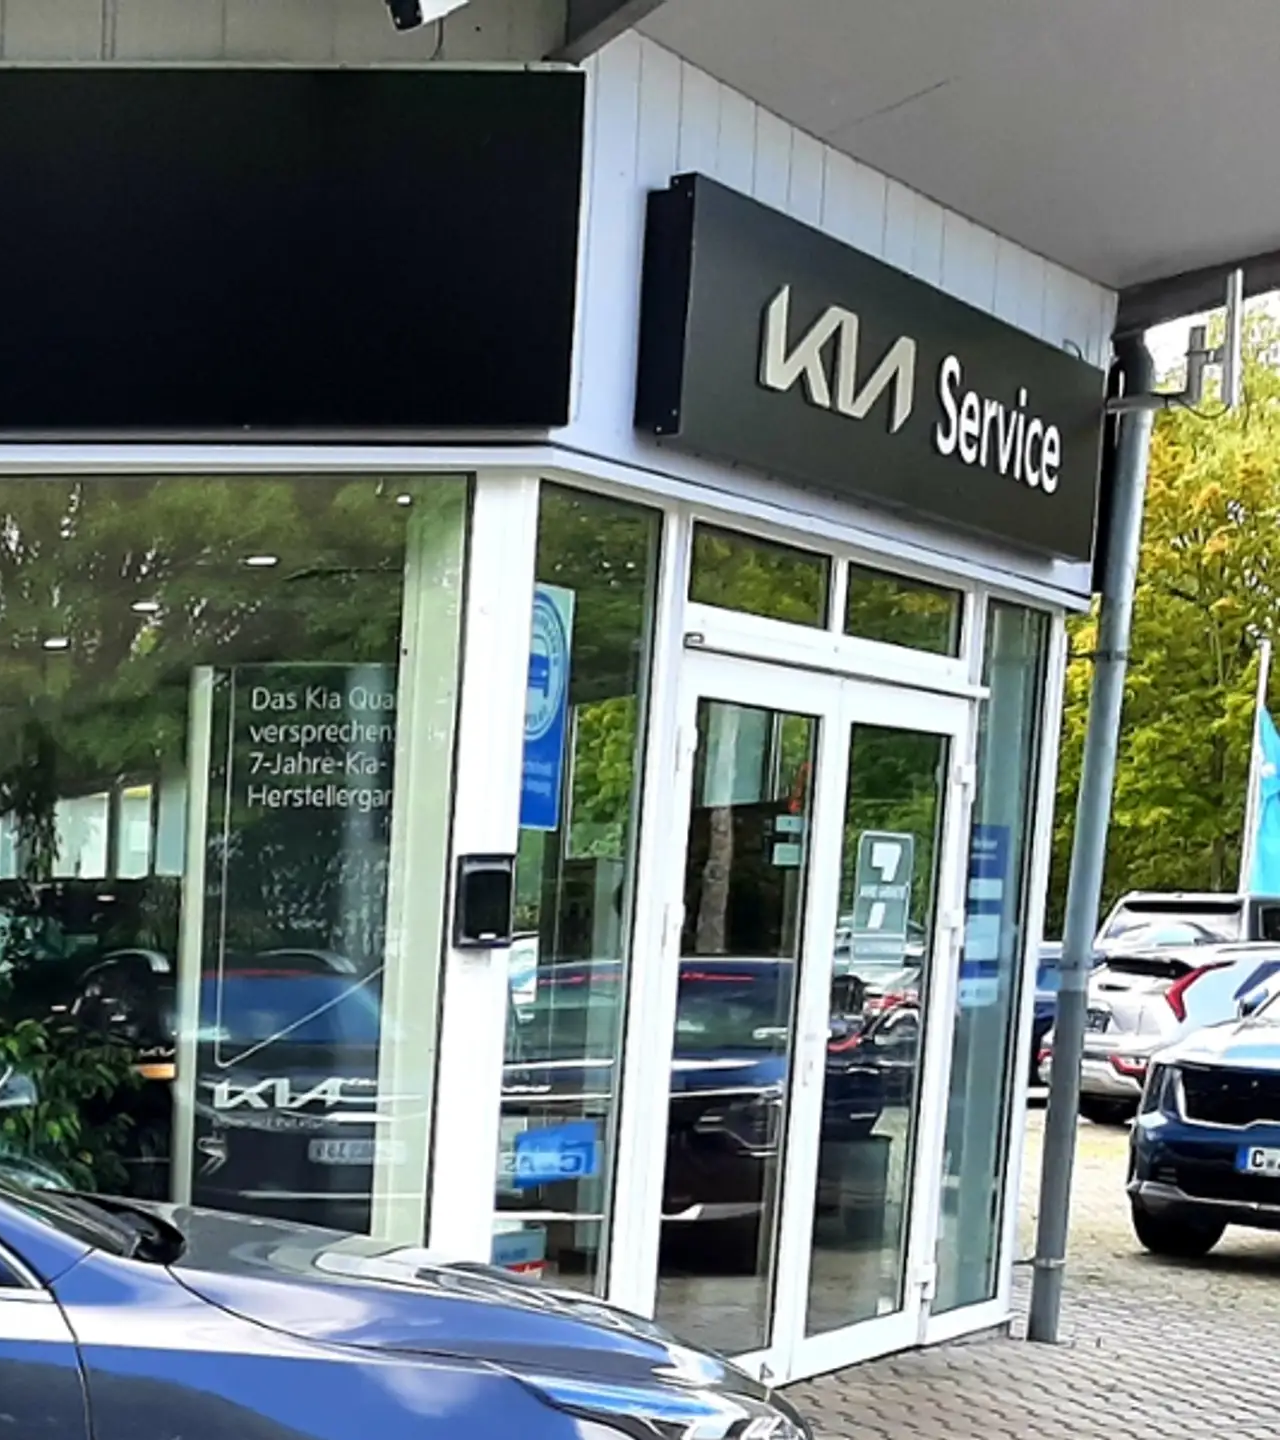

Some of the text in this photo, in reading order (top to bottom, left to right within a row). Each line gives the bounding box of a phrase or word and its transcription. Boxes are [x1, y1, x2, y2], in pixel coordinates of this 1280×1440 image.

[761, 283, 1061, 494] KIA Service
[251, 686, 298, 711] Das
[305, 685, 341, 710] Kia
[249, 751, 387, 776] 7-Jahre-Kia-
